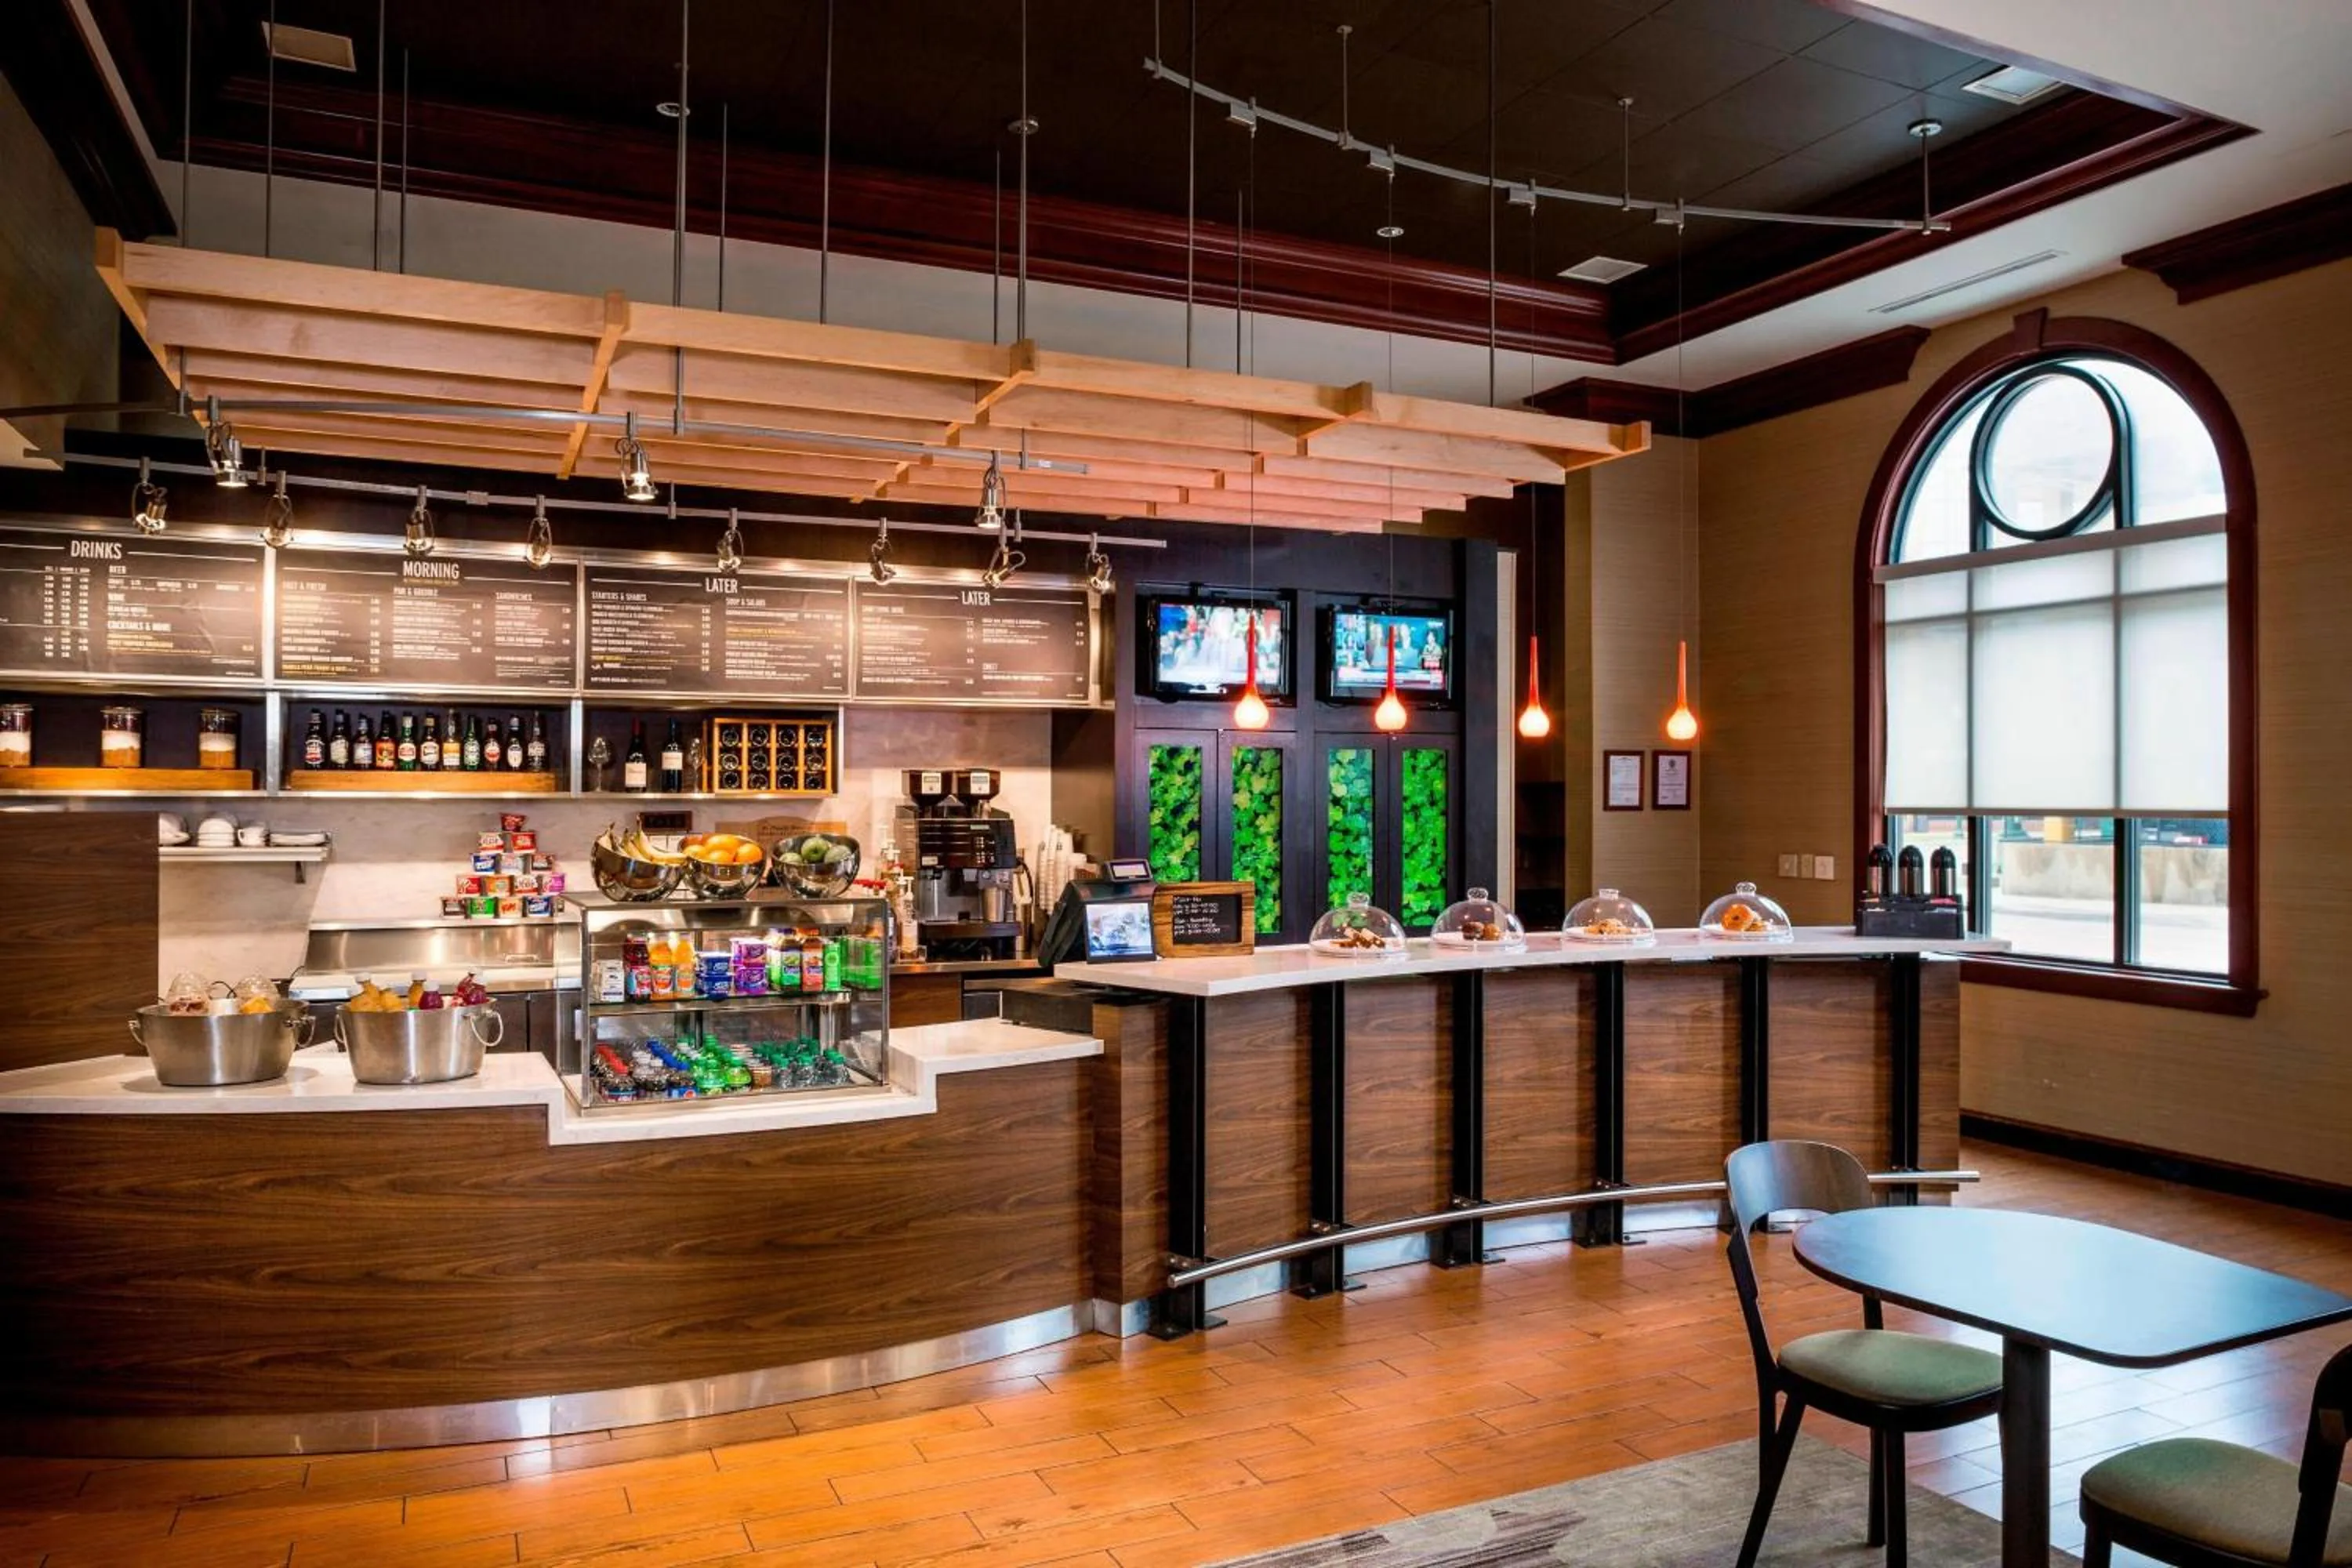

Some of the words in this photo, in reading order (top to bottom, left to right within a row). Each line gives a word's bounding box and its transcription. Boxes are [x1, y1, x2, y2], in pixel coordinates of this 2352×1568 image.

[70, 540, 122, 560] DRINKS
[403, 561, 459, 579] MORNING
[705, 578, 738, 593] LATER
[962, 590, 991, 605] LATER
